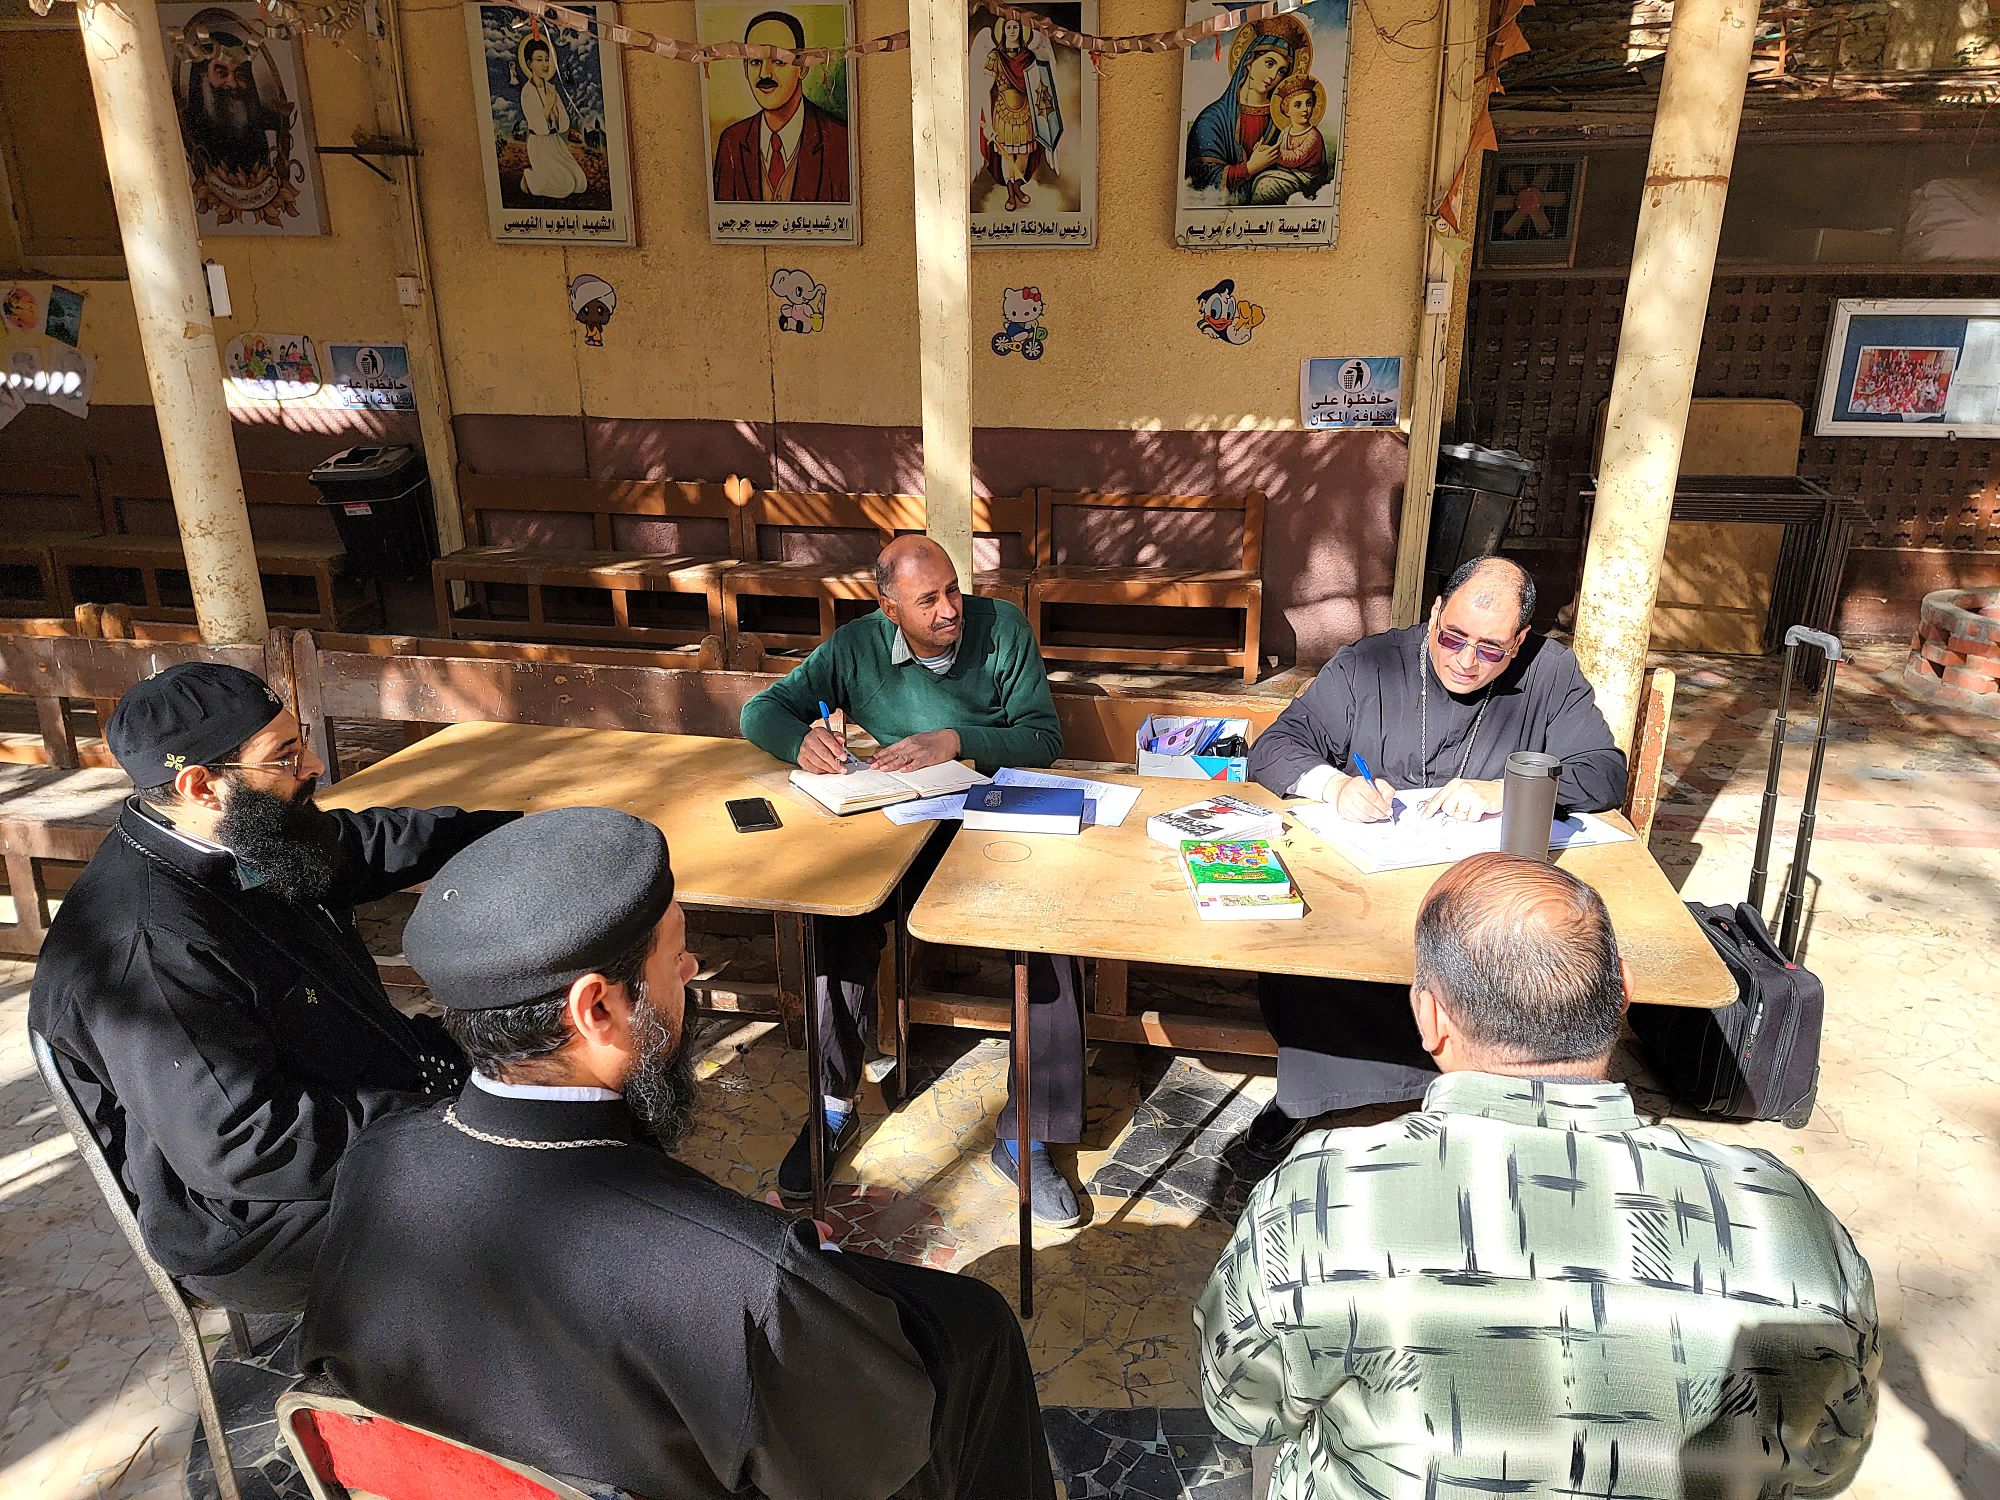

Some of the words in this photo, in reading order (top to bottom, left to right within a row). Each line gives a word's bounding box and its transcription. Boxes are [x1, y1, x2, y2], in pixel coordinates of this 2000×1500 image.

[545, 214, 579, 234] أبانوب
[582, 215, 616, 234] الشهيد
[717, 216, 751, 232] جرجس
[754, 217, 779, 233] حبيب
[988, 222, 1018, 238] الجليل
[1020, 219, 1058, 235] الملائكة
[1059, 220, 1087, 238] رئيس
[1225, 219, 1273, 238] العذراء
[1277, 217, 1326, 238] القديسة
[1185, 224, 1222, 241] مريم
[340, 378, 362, 391] على
[364, 378, 408, 392] حافظوا
[342, 393, 373, 407] المكان
[1311, 394, 1338, 409] على
[1343, 392, 1394, 408] حافظوا
[1310, 411, 1348, 425] المكان
[1352, 409, 1397, 423] نظافة
